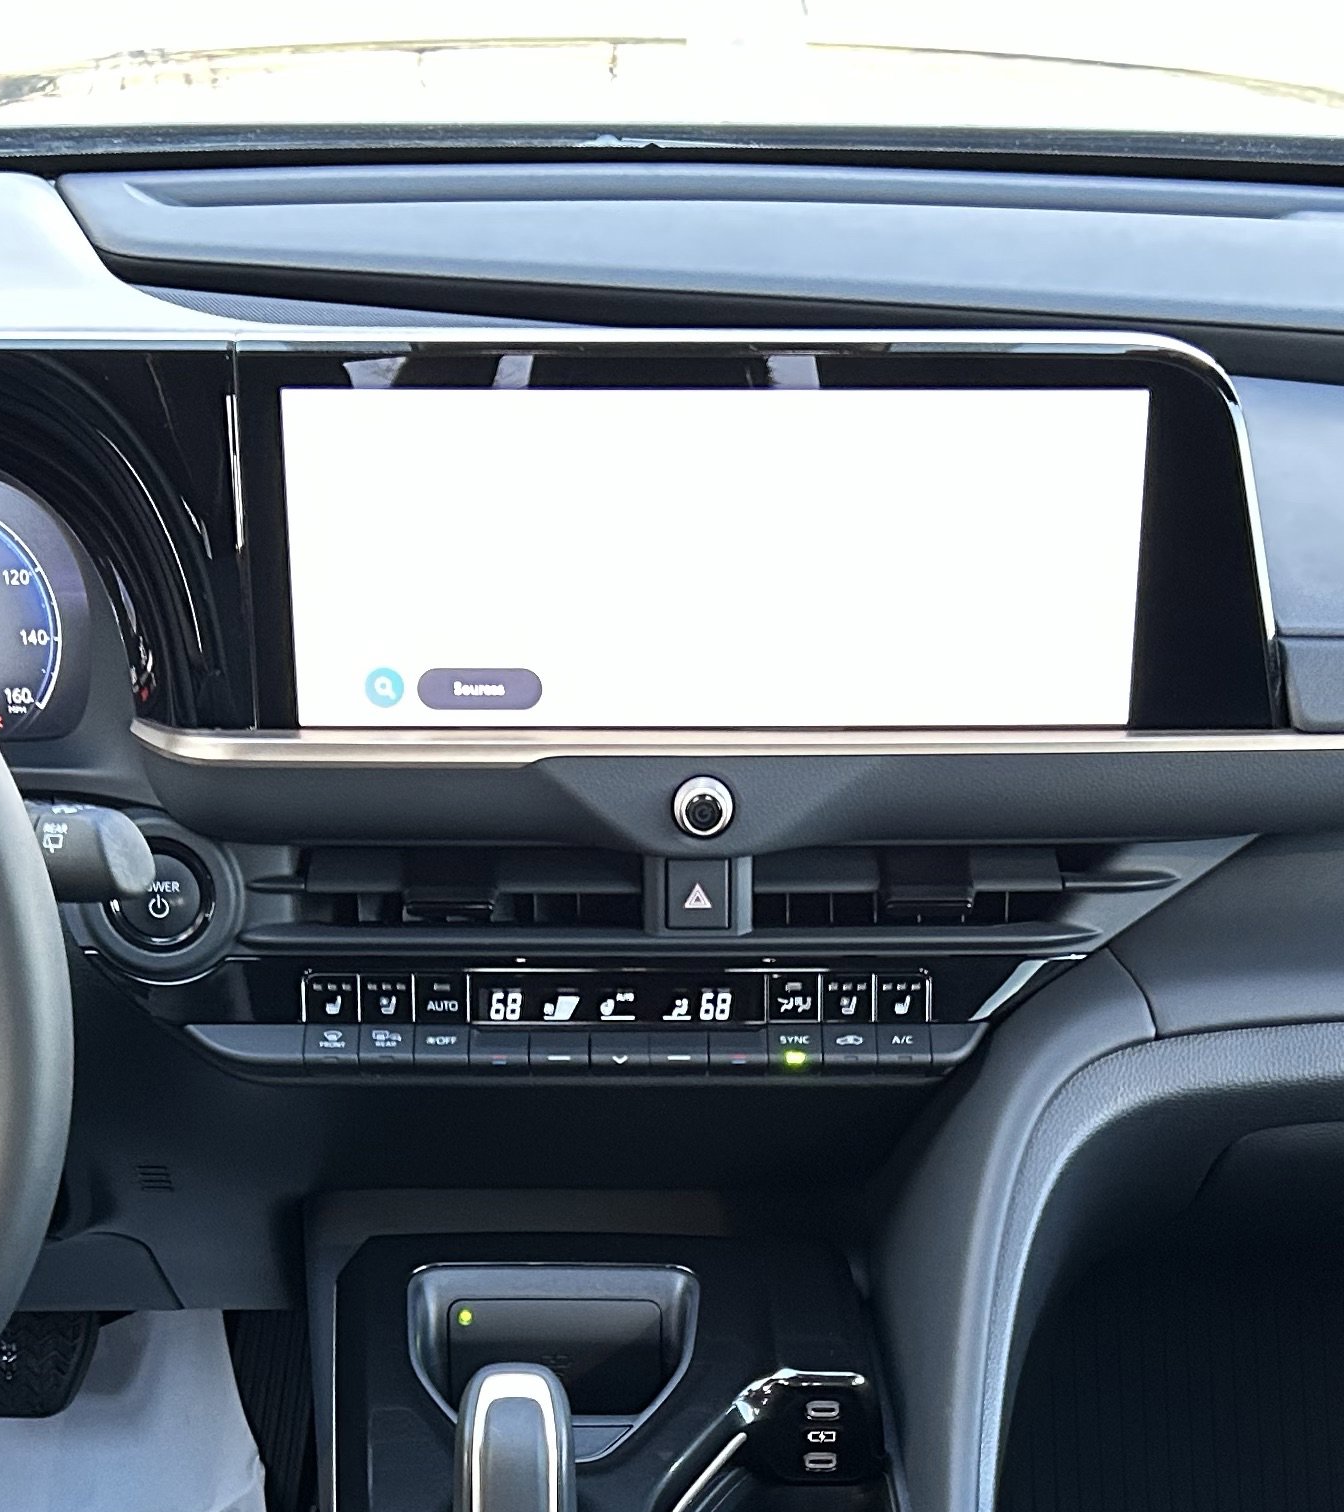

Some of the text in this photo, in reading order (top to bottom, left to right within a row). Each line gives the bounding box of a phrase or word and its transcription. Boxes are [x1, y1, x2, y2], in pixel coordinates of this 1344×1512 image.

[3, 569, 29, 586] 120
[19, 629, 47, 646] 140
[4, 687, 32, 704] 160
[147, 880, 180, 893] WER
[426, 1000, 459, 1012] AUTO
[489, 992, 523, 1021] 68
[699, 992, 732, 1021] 68
[319, 1041, 346, 1049] FRONT
[437, 1036, 457, 1045] OFF
[779, 1035, 811, 1045] SYNC
[891, 1035, 913, 1045] A/C
